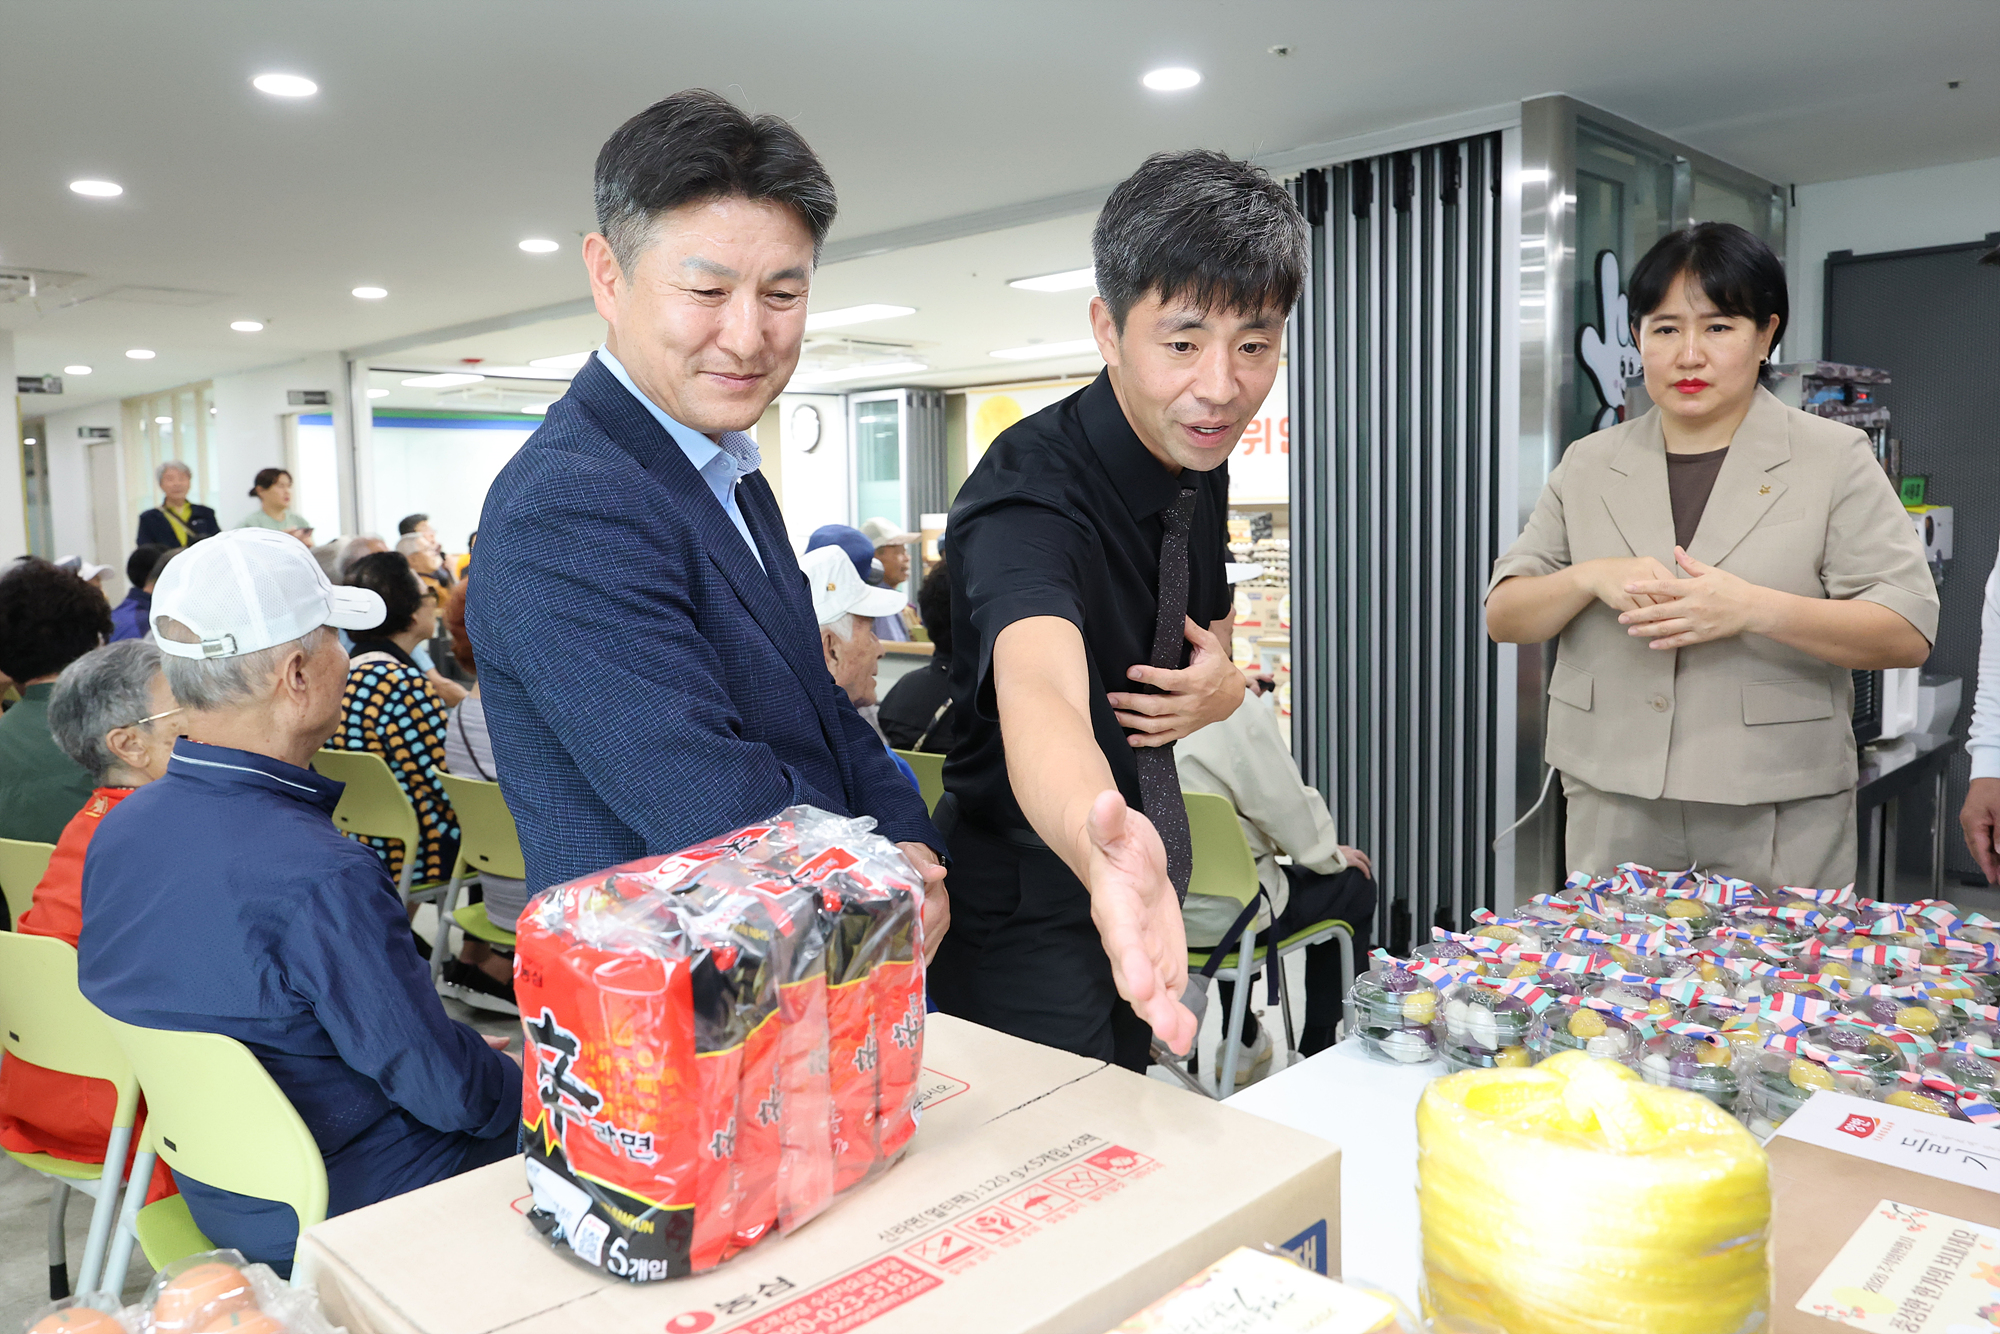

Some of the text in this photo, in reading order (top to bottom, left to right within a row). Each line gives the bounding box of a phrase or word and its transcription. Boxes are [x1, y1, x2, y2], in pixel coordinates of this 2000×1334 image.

[588, 1121, 659, 1163] 라면
[606, 1236, 668, 1282] 5개입
[1932, 1229, 1979, 1269] 보내세요
[714, 1275, 796, 1315] 농심
[768, 1267, 923, 1334] 80-023-5181
[1911, 1265, 1956, 1300] 한가위
